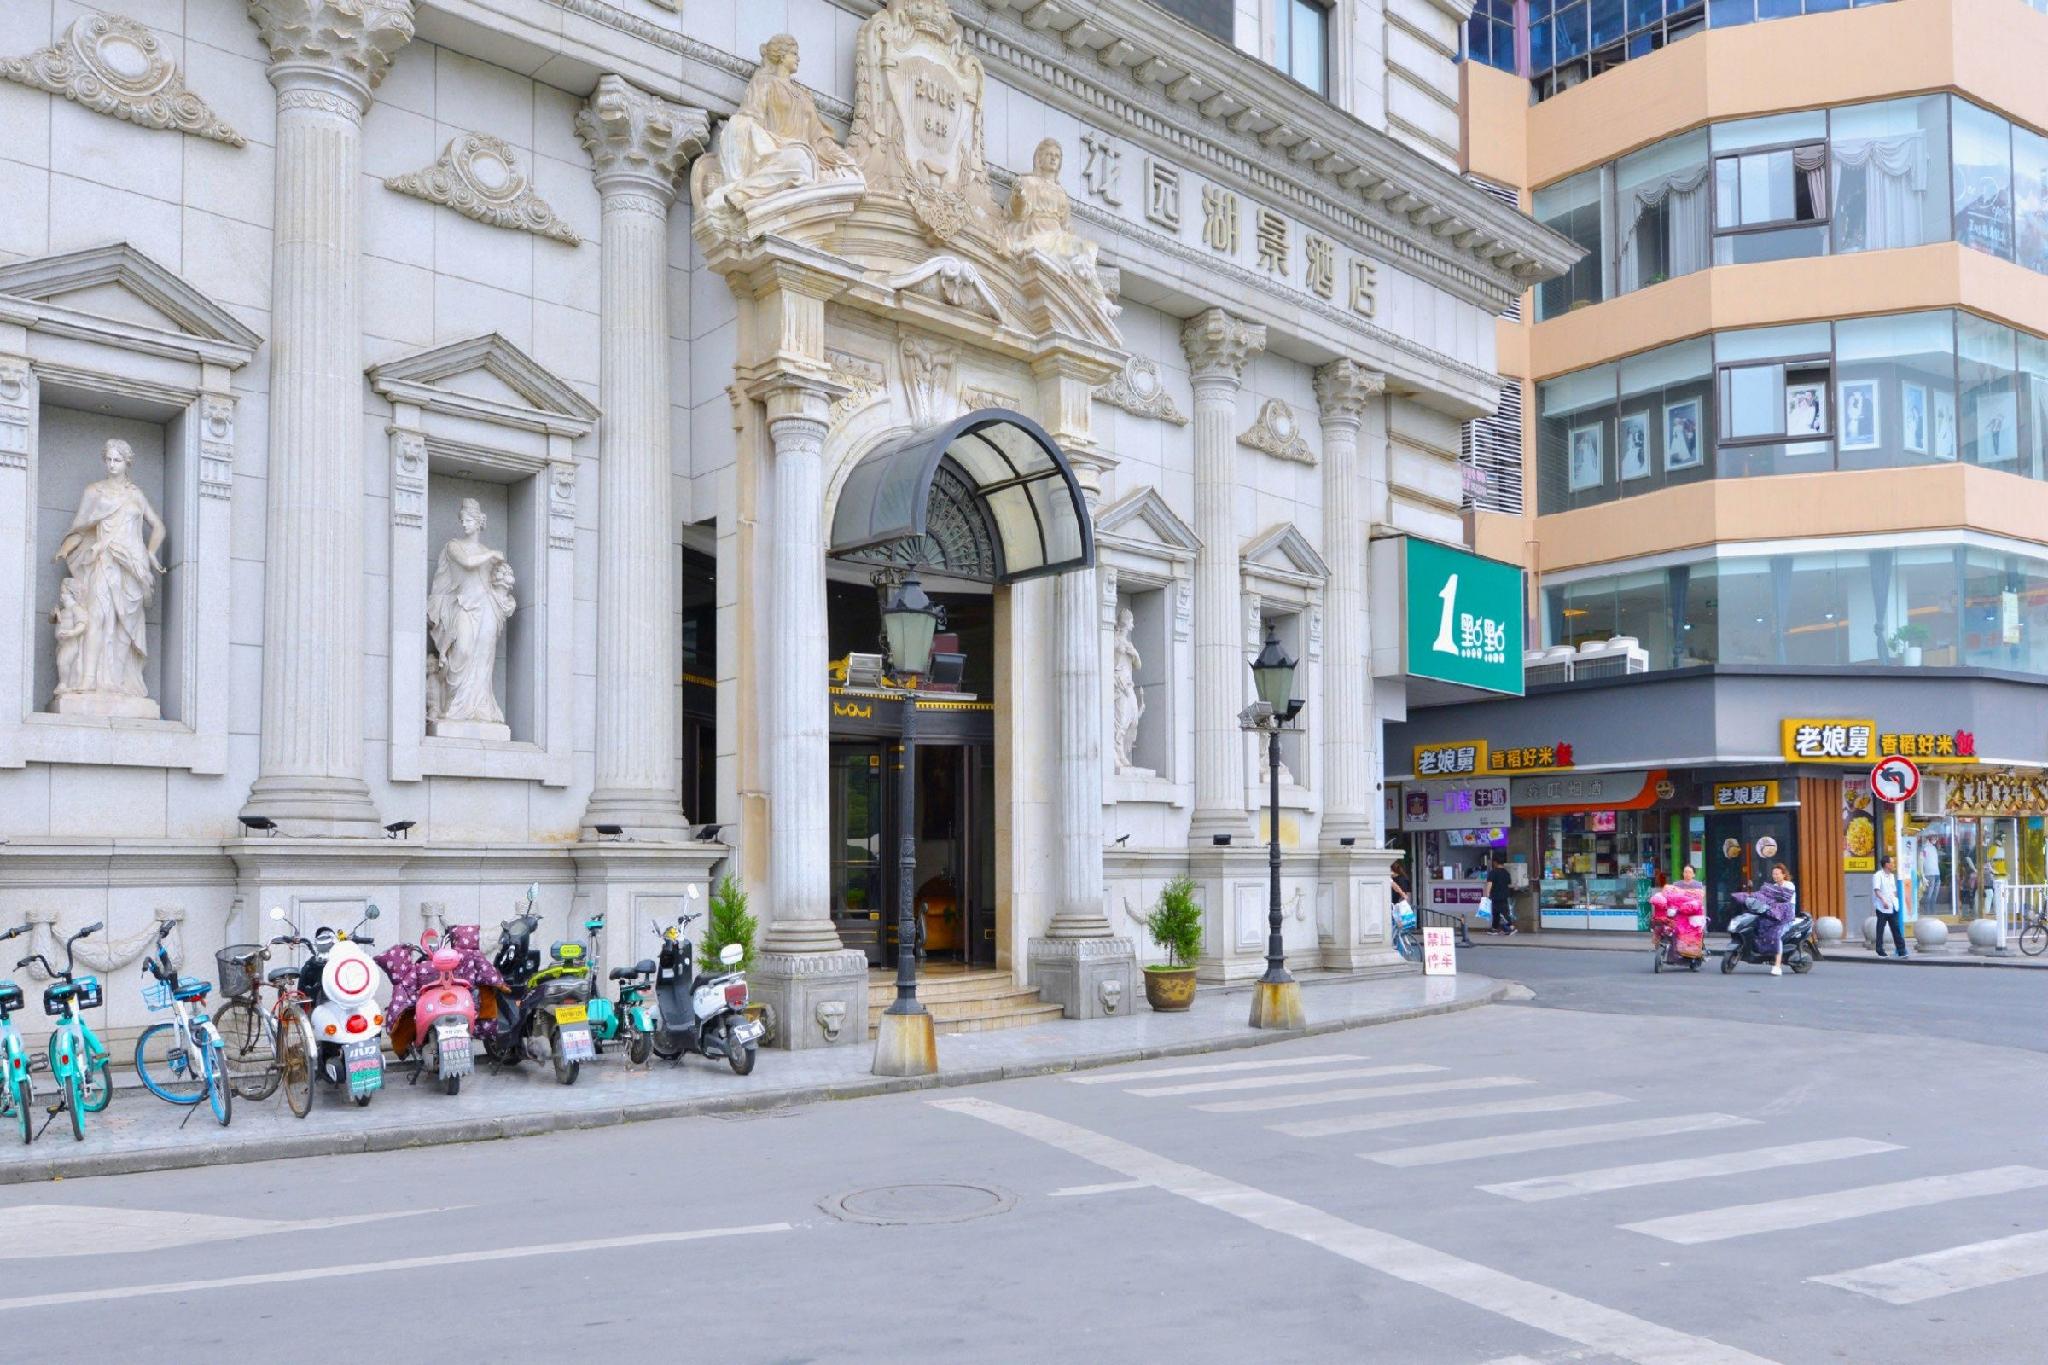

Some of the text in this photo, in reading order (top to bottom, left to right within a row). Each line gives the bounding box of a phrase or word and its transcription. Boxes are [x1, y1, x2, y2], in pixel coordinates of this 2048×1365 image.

[1080, 131, 1378, 318] 花园湖景酒店
[1796, 725, 1870, 757] 老娘舅
[1418, 746, 1476, 774] 老娘舅
[1718, 786, 1767, 805] 老娘舅
[1427, 931, 1452, 947] 禁止
